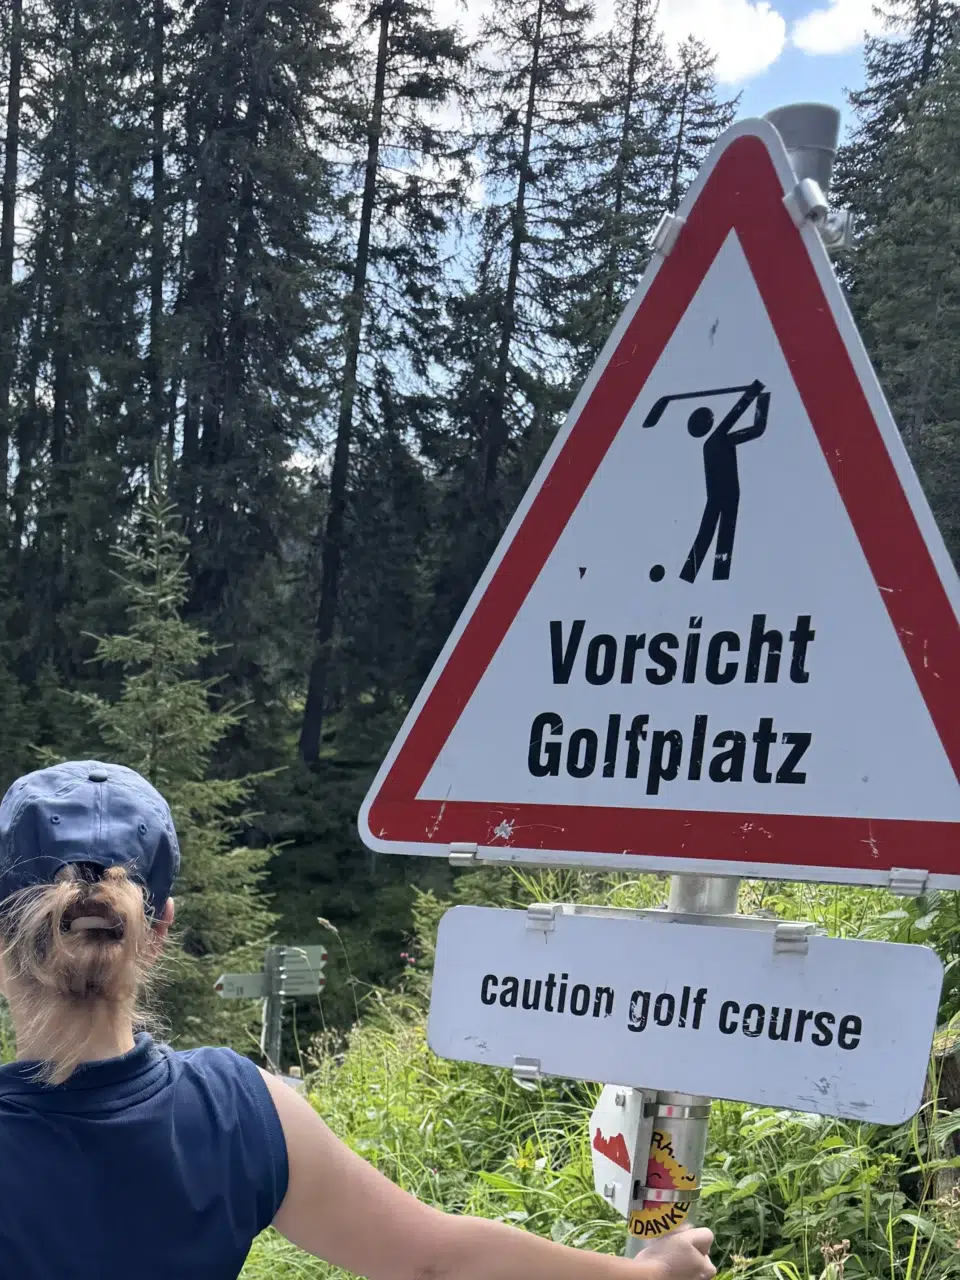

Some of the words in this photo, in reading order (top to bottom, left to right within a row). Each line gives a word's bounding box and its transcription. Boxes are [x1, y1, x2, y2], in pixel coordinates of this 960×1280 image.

[549, 613, 816, 686] Vorsicht
[527, 711, 812, 796] Golfplatz
[480, 972, 614, 1018] caution
[627, 985, 707, 1033] golf
[718, 999, 862, 1051] course
[633, 1201, 691, 1236] DANKE
